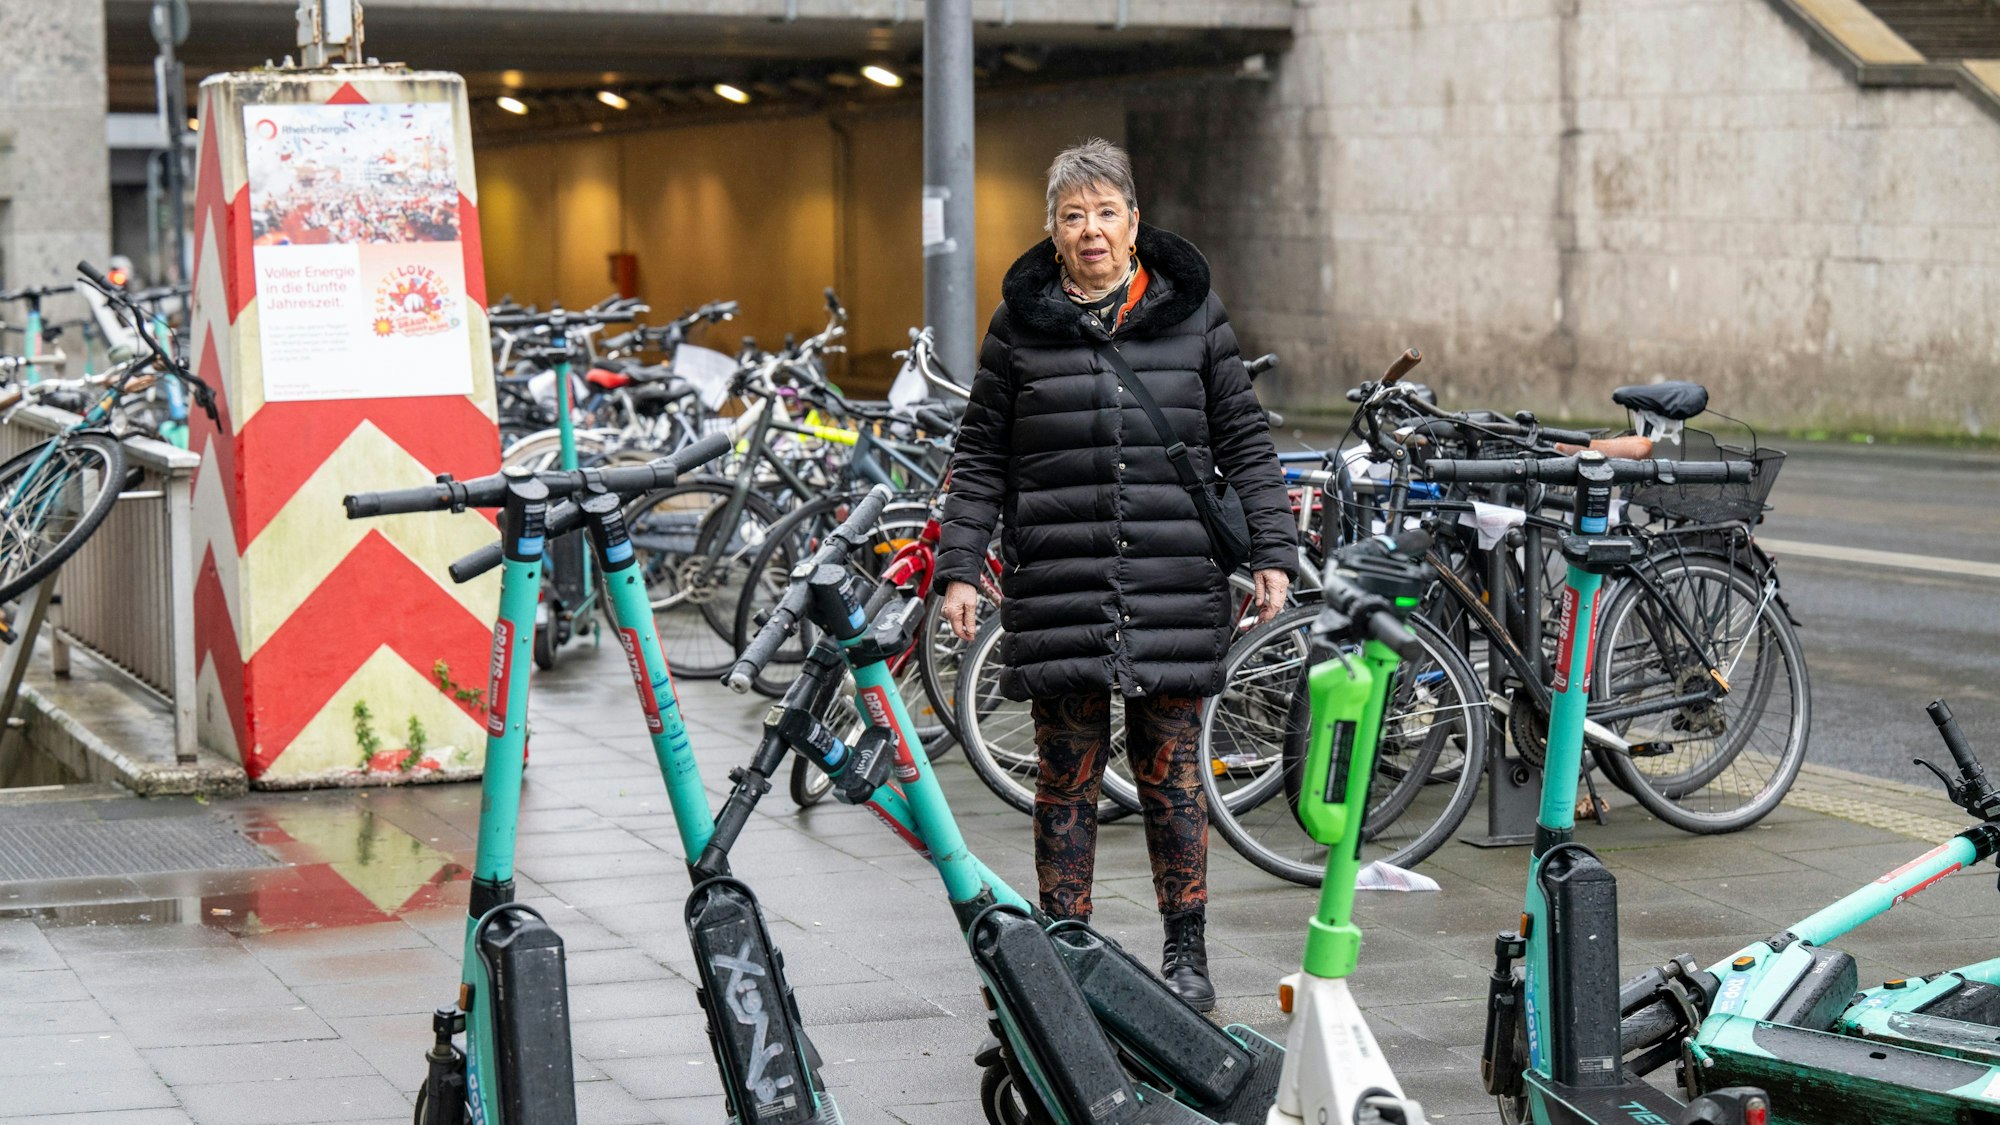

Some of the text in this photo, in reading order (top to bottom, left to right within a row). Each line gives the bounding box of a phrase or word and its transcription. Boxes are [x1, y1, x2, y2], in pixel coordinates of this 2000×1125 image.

[281, 125, 349, 136] RheinEnergie
[264, 265, 356, 279] Voller Energie
[266, 281, 347, 294] in die fünfte
[267, 298, 345, 310] Jahreszeit.
[1559, 590, 1573, 640] GRATIS
[492, 622, 507, 679] GRATIS
[620, 632, 643, 682] GRATIS
[863, 692, 891, 727] GRATI
[1813, 954, 1834, 975] TIER
[1527, 998, 1538, 1052] dott
[1618, 1100, 1672, 1125] TIE
